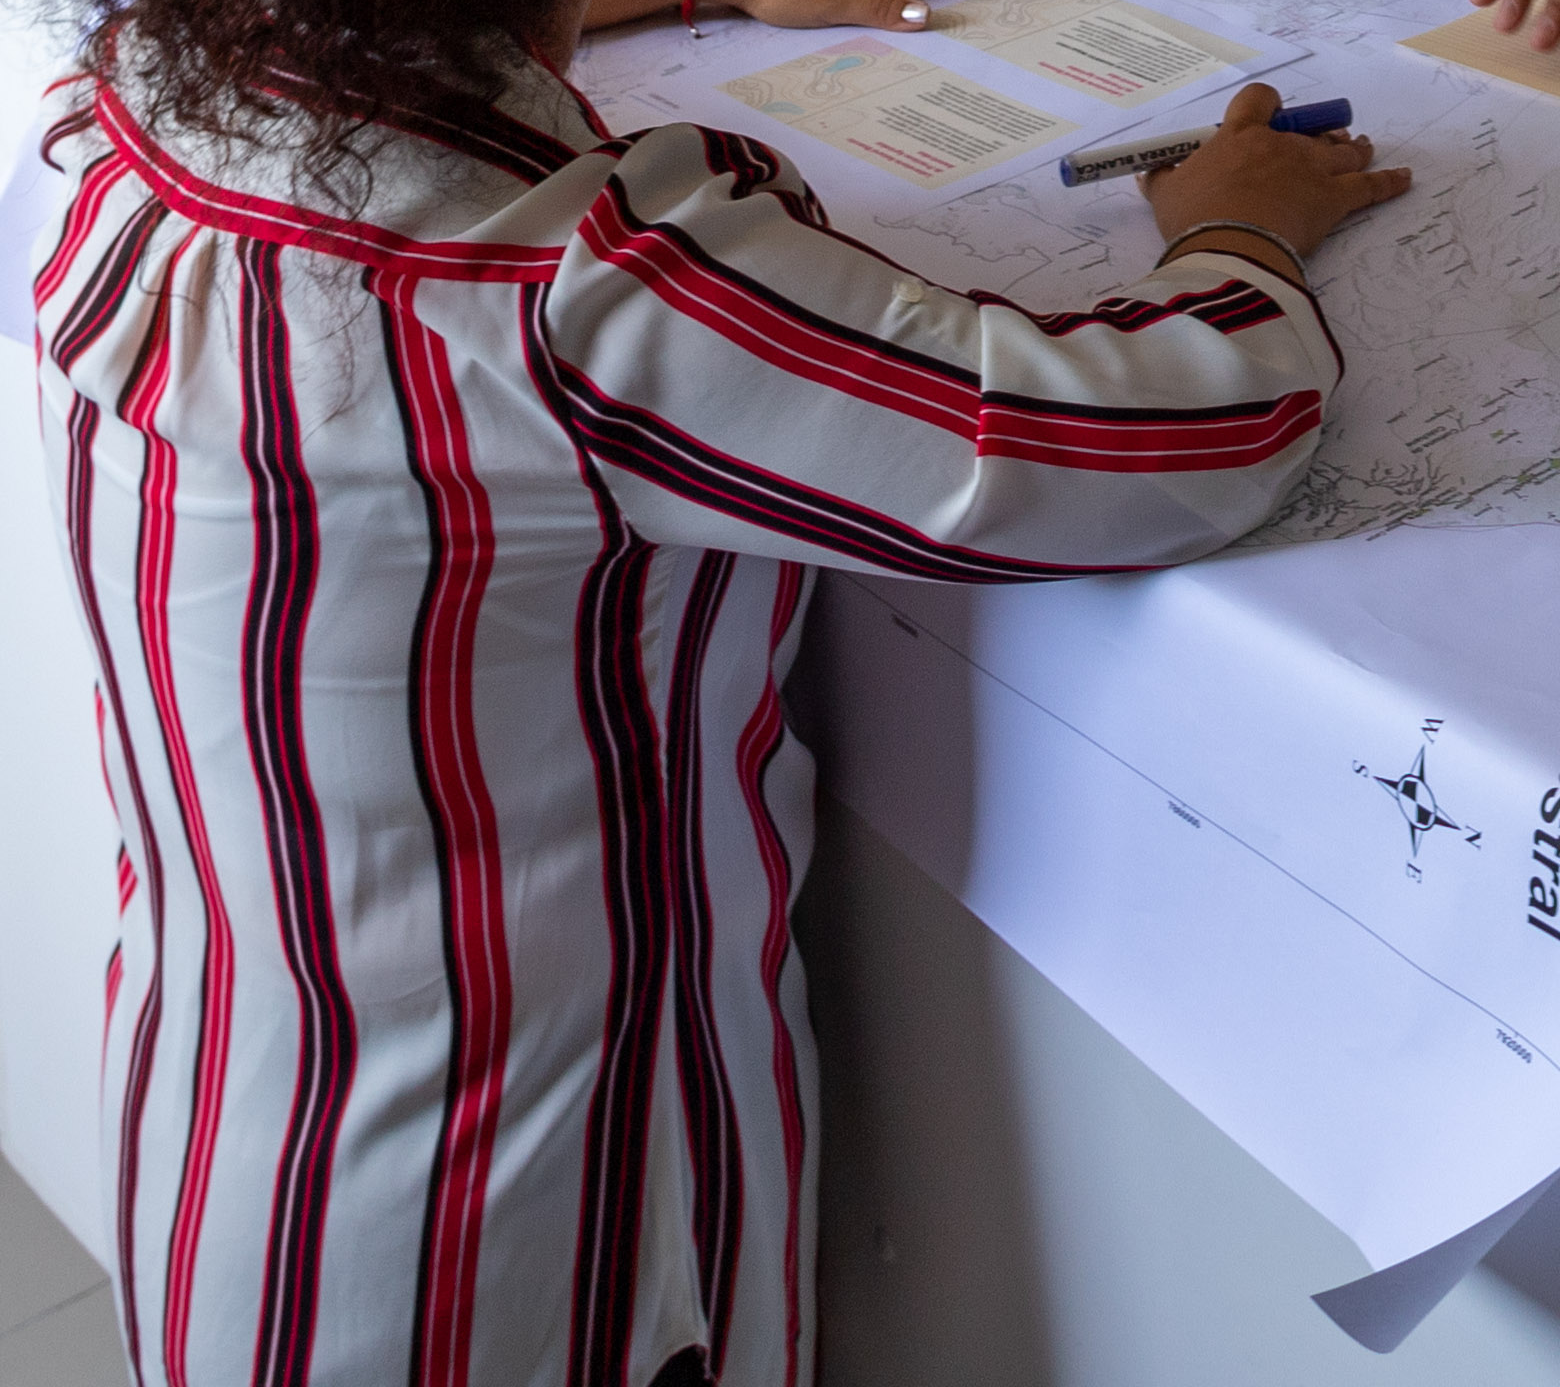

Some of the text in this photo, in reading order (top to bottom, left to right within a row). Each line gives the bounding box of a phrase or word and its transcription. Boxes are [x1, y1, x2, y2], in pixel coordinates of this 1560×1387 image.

[1138, 139, 1200, 163] PIZARRA
[1075, 154, 1134, 177] BLANCA
[1420, 717, 1446, 745] W
[1352, 759, 1370, 780] S
[1463, 825, 1483, 851] N
[1406, 860, 1423, 885] E
